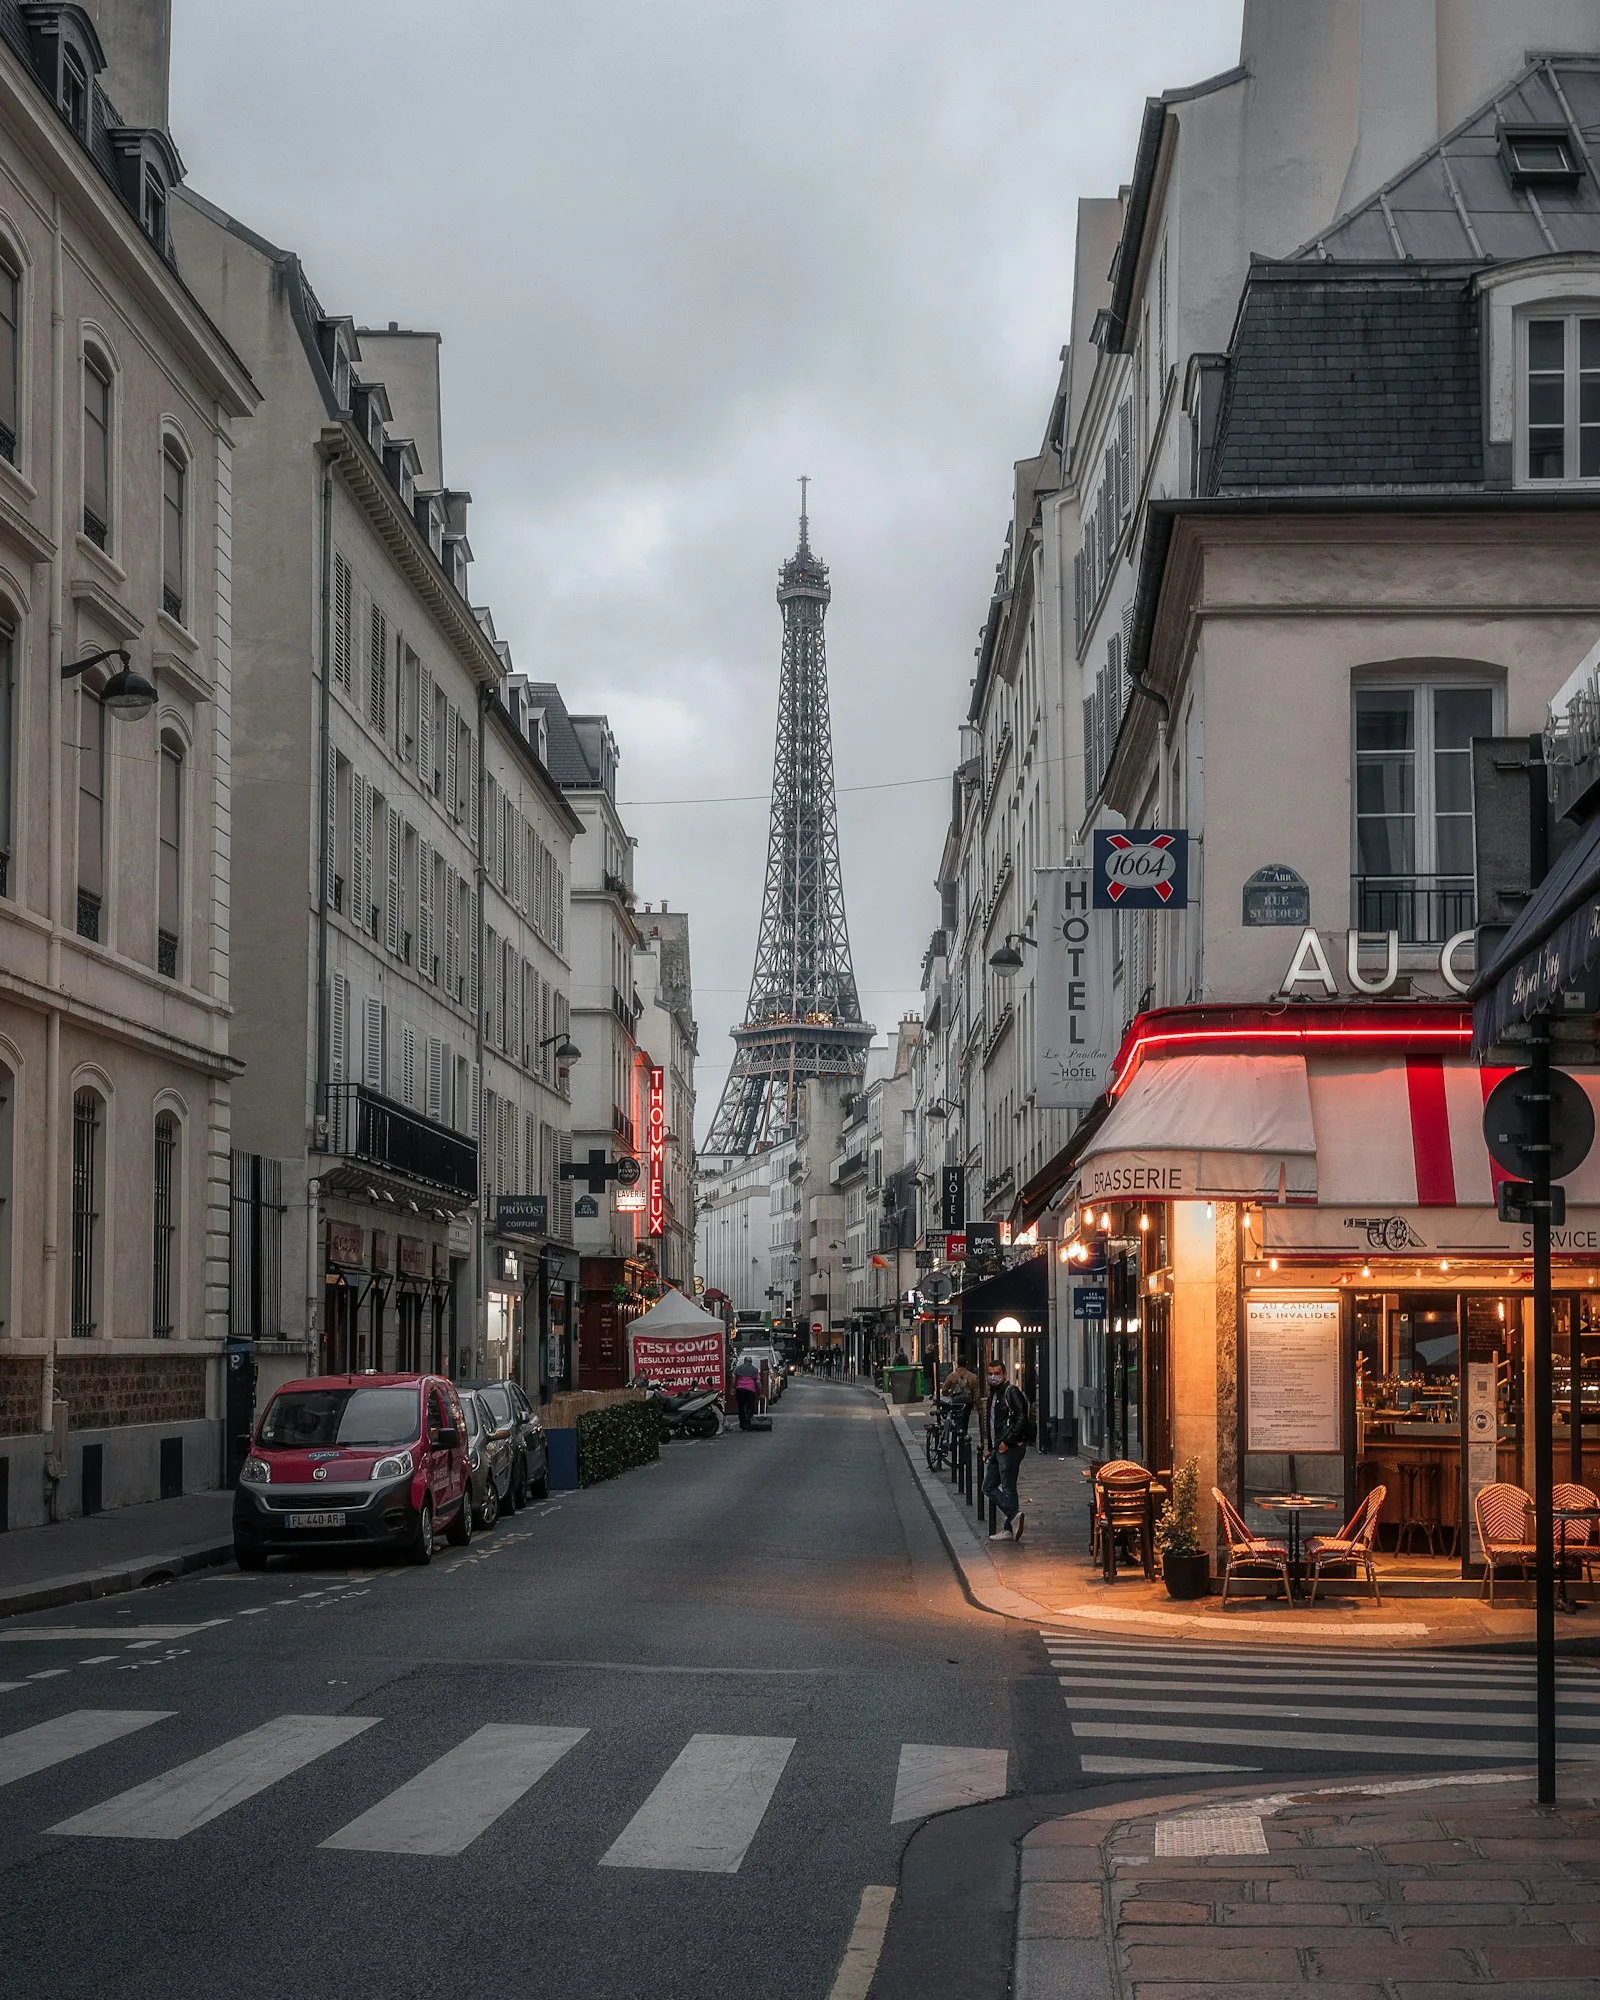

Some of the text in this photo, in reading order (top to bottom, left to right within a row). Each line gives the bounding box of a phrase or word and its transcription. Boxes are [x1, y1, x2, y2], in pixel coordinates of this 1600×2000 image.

[1112, 850, 1168, 877] 1664
[1264, 896, 1289, 906] RUE
[1062, 881, 1089, 1044] HOTEL
[1278, 927, 1399, 997] AU
[1043, 1047, 1107, 1059] Le Pavillon
[1061, 1068, 1097, 1077] HOTEL
[650, 1070, 663, 1234] THOUMIEUX
[1094, 1168, 1182, 1194] BRASSERIE
[617, 1190, 646, 1198] LAVERIE
[499, 1205, 546, 1214] PROVOST
[505, 1220, 539, 1228] COIFFURE
[638, 1339, 719, 1354] TEST COVID
[638, 1356, 675, 1364] RESULTAT
[686, 1354, 719, 1362] MINUTES
[664, 1367, 692, 1375] CARTE
[692, 1365, 720, 1373] VITALE
